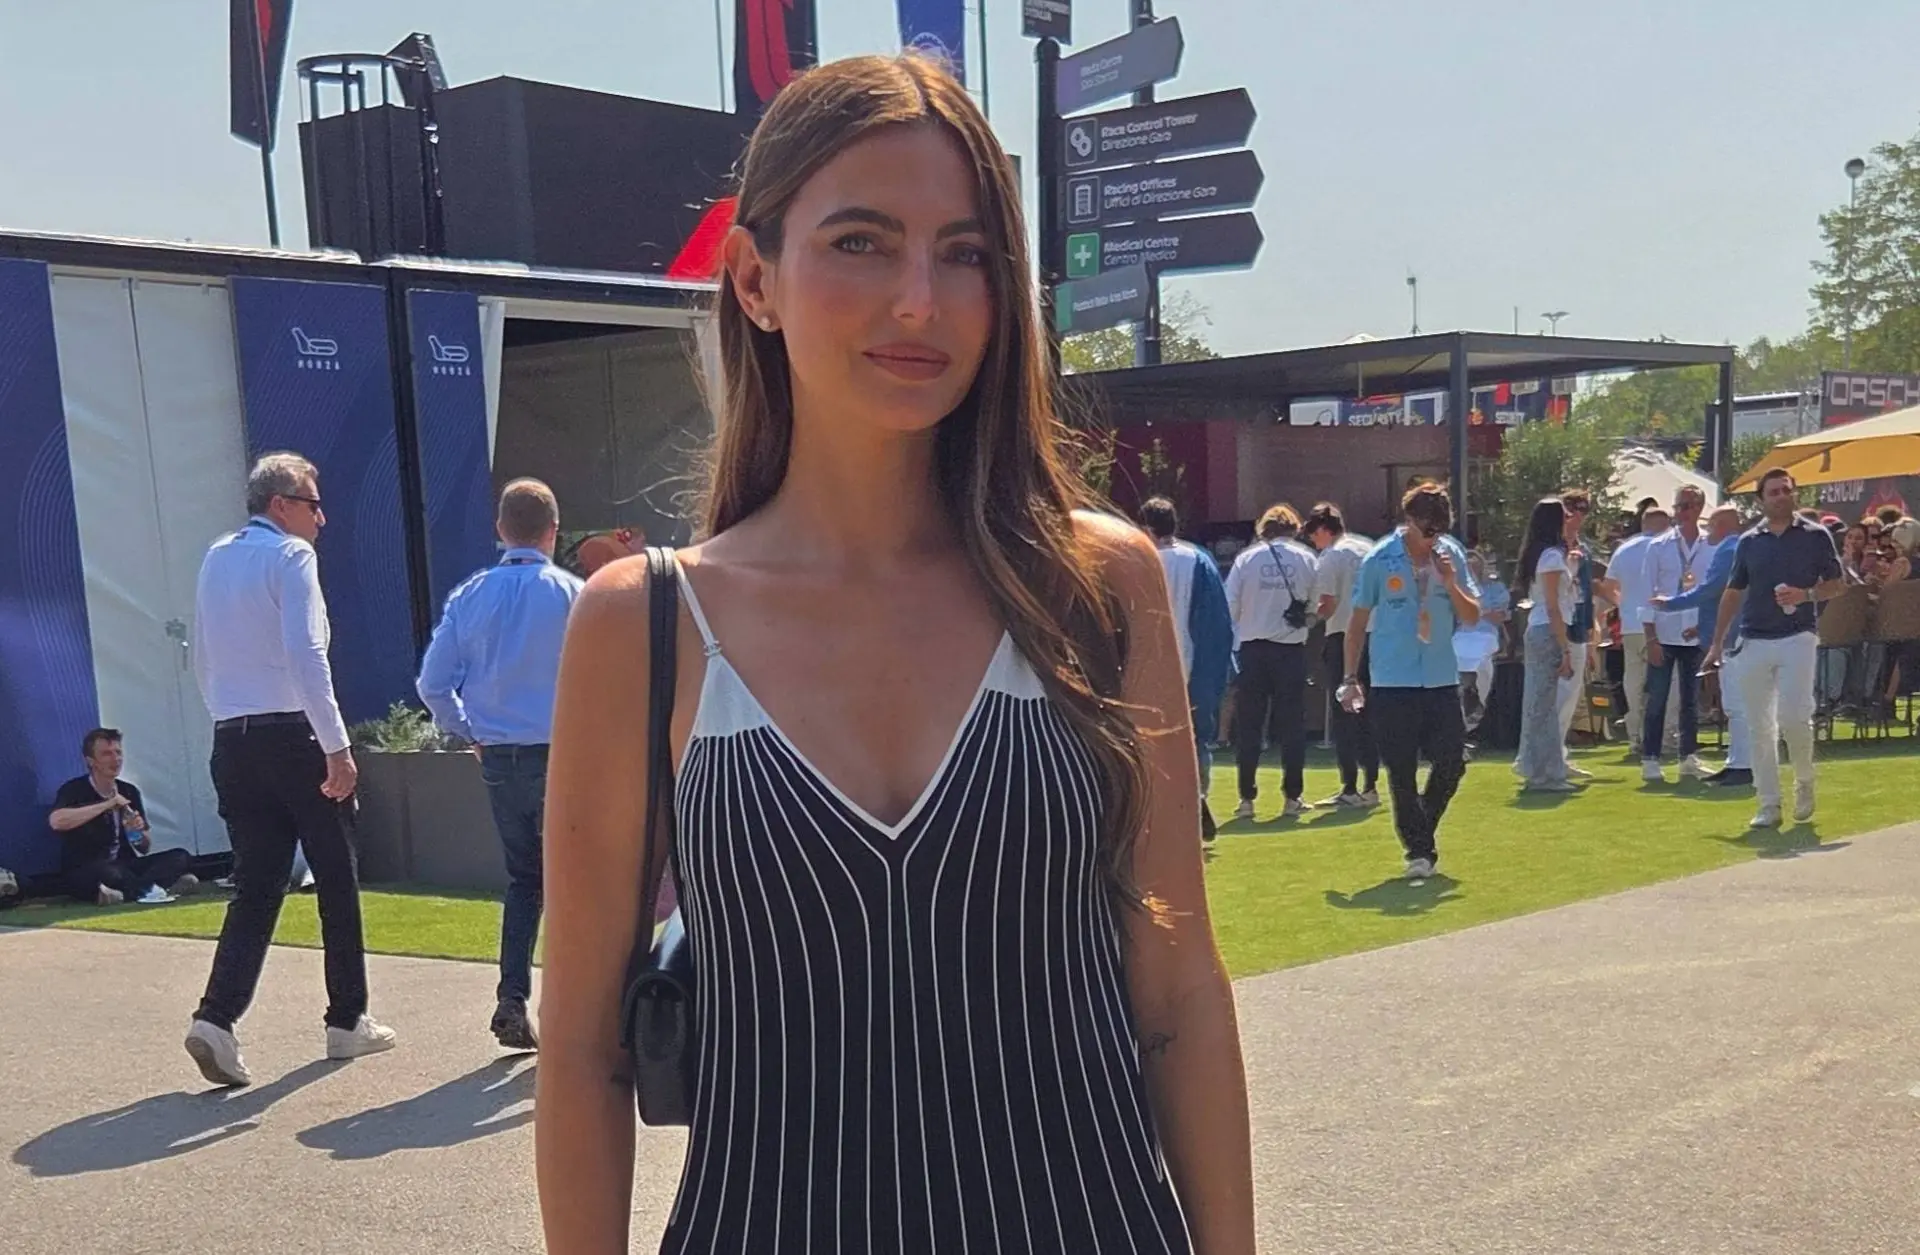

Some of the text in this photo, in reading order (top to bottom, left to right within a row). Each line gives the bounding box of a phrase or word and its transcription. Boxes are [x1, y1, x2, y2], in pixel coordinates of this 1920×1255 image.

[1101, 114, 1198, 138] Race Control Tower
[1101, 131, 1172, 151] Direzione Gara
[1104, 177, 1178, 196] Racing Offices
[1142, 189, 1191, 204] Direzione
[1192, 185, 1217, 198] Gara
[1104, 236, 1180, 253] Medical Centre
[1104, 254, 1138, 266] Centro
